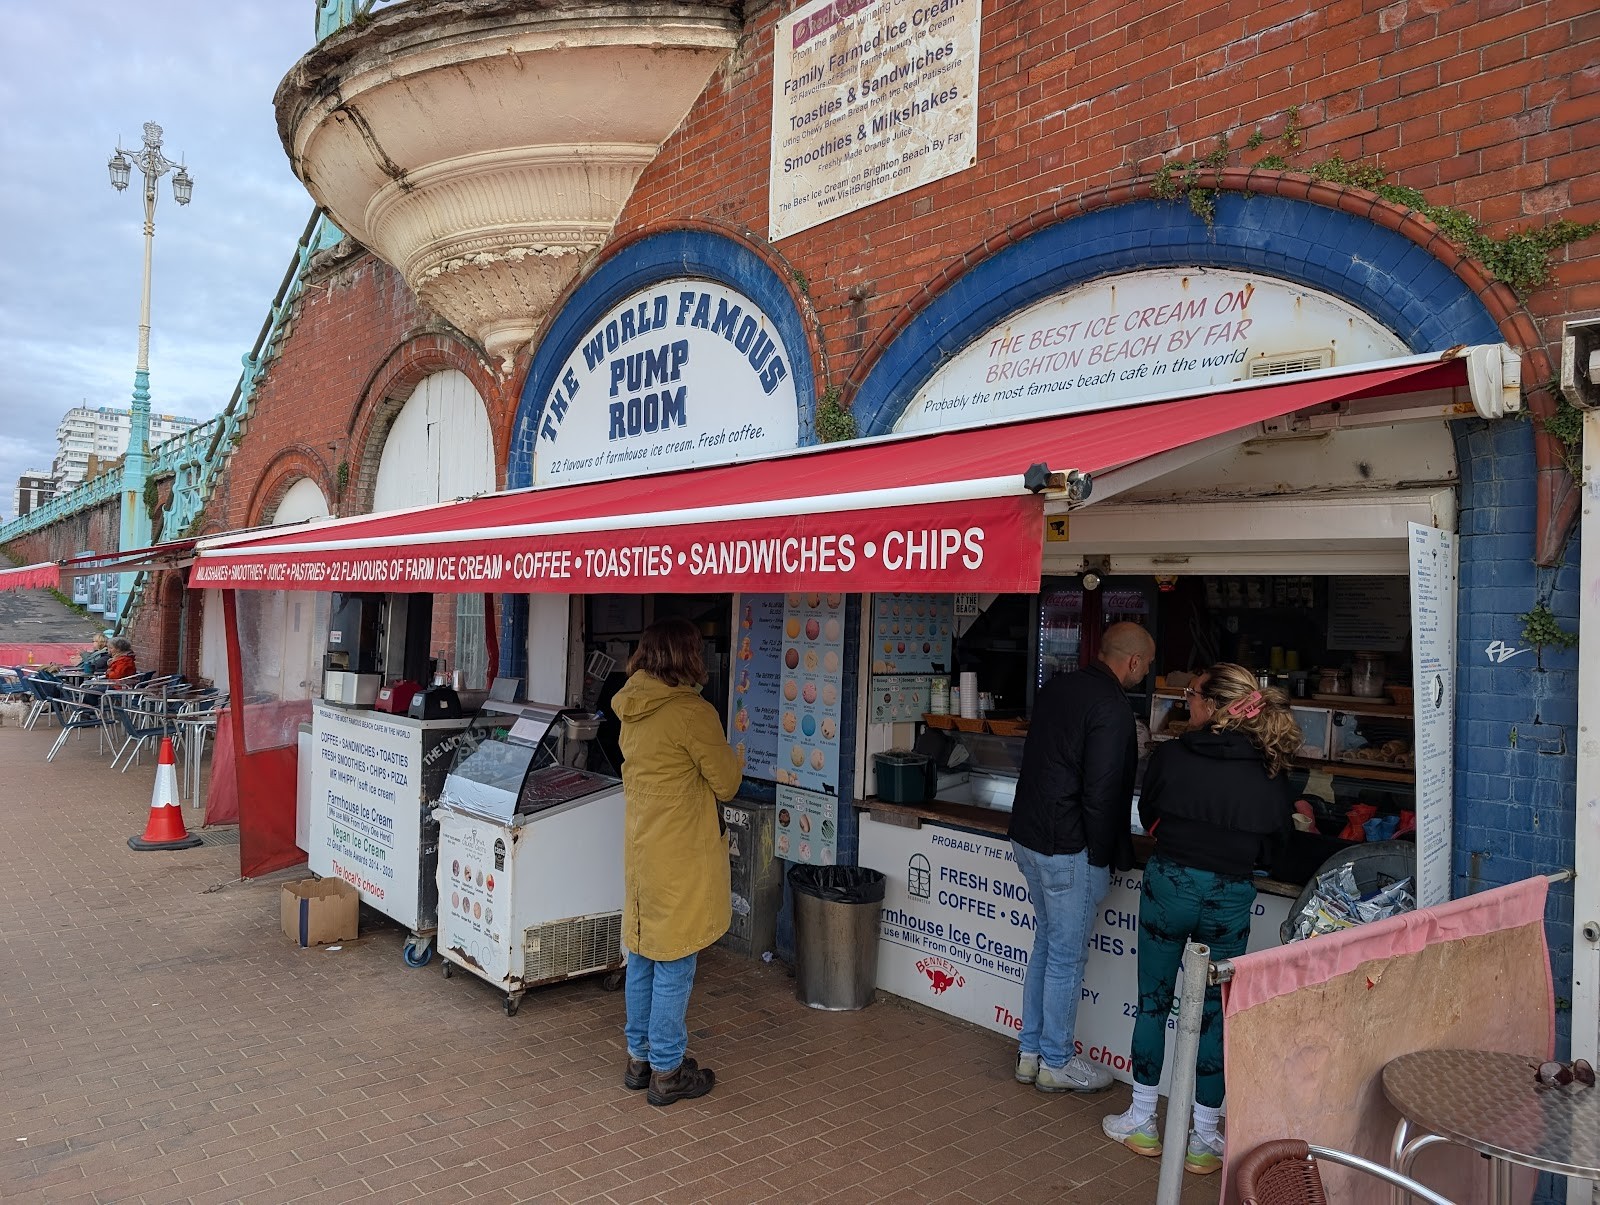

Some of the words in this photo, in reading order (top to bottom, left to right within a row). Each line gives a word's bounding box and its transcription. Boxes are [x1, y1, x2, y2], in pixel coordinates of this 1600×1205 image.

[784, 65, 824, 95] Family
[829, 30, 880, 71] Farmed
[886, 21, 907, 41] Ice
[790, 94, 798, 105] 22
[798, 81, 826, 101] Flavours
[836, 65, 858, 81] Family
[860, 47, 887, 68] Farmed
[915, 30, 927, 42] Ice
[928, 15, 955, 33] Cream
[814, 37, 827, 51] the
[783, 135, 800, 149] Using
[801, 125, 823, 139] Chewy
[824, 113, 846, 129] Brown
[847, 101, 868, 117] Bread
[870, 93, 887, 107] from
[889, 88, 901, 99] the
[903, 78, 920, 90] Real
[922, 58, 962, 80] Patisserie
[790, 97, 842, 131] Toasties
[847, 87, 857, 104] &
[861, 42, 954, 97] Sandwiches
[784, 133, 852, 173] Smoothies
[857, 124, 867, 141] &
[872, 86, 958, 135] Milkshakes
[817, 155, 842, 173] Freshly
[844, 148, 862, 160] Made
[864, 136, 891, 153] Orange
[893, 128, 913, 141] Juice
[779, 201, 792, 213] The
[793, 194, 810, 208] Best
[811, 189, 822, 200] Ice
[824, 178, 849, 194] Cream
[851, 173, 861, 183] on
[863, 157, 900, 178] Brighton
[902, 145, 930, 163] Beach
[932, 139, 945, 151] By
[947, 131, 964, 145] Far
[817, 164, 911, 208] www.VisitBrighton.com
[989, 333, 1026, 358] THE
[1028, 321, 1083, 350] BEST
[1083, 314, 1120, 340] ICE
[1124, 297, 1208, 332] CREAM
[1214, 287, 1256, 316] ON
[540, 366, 581, 444] THE
[582, 294, 669, 374] WORLD
[676, 291, 788, 396] FAMOUS
[609, 339, 690, 399] PUMP
[985, 348, 1084, 384] BRIGHTON
[1087, 334, 1162, 366] BEACH
[1166, 325, 1202, 353] BY
[1203, 318, 1253, 346] FAR
[923, 393, 970, 413] Probably
[971, 391, 991, 406] the
[993, 385, 1025, 403] most
[1026, 379, 1073, 397] famous
[1076, 369, 1116, 388] beach
[1119, 363, 1149, 382] cafe
[1152, 360, 1167, 376] in
[1171, 357, 1197, 374] the
[1201, 347, 1249, 370] world
[608, 385, 688, 442] ROOM
[551, 460, 561, 474] 22
[563, 458, 593, 472] flavours
[595, 452, 605, 467] of
[606, 446, 648, 465] farmhouse
[650, 444, 663, 457] ice
[665, 439, 695, 454] cream.
[698, 428, 726, 448] Fresh
[728, 423, 765, 443] coffee.
[195, 565, 229, 581] MILKSHAKES
[230, 563, 264, 581] SMOOTHIES
[266, 563, 288, 581] JUICE
[290, 562, 326, 581] PASTRIES
[330, 561, 341, 581] 22
[341, 559, 388, 581] FLAVOURS
[390, 558, 403, 581] OF
[405, 557, 434, 581] FARM
[436, 556, 455, 580] ICE
[458, 554, 503, 580] CREAM
[513, 551, 571, 579] COFFEE
[584, 544, 673, 578] TOASTIES
[688, 533, 856, 576] SANDWICHES
[882, 527, 985, 570] CHIPS
[966, 596, 977, 605] THE
[321, 731, 339, 747] COFFEE
[342, 738, 375, 758] SANDWICHES
[380, 749, 409, 768] TOASTIES
[322, 748, 336, 762] FRESH
[337, 753, 366, 773] SMOOTHIES
[370, 764, 387, 780] CHIPS
[391, 771, 408, 788] PIZZA
[423, 743, 443, 766] THE
[328, 789, 360, 815] Farmhouse
[361, 803, 370, 819] Ice
[371, 808, 393, 830] Cream
[378, 787, 396, 805] cream)
[332, 823, 351, 844] Vegan
[352, 832, 361, 848] Ice
[364, 838, 386, 861] Cream
[351, 816, 361, 828] From
[361, 821, 370, 835] Only
[371, 827, 379, 838] One
[931, 834, 981, 854] PROBABLY
[984, 846, 1002, 860] THE
[332, 859, 342, 875] The
[342, 866, 361, 888] local's
[362, 879, 385, 900] choice
[940, 866, 988, 892] FRESH
[938, 890, 996, 920] COFFEE
[884, 927, 900, 938] use
[902, 930, 920, 945] Milk
[922, 937, 947, 954] From
[949, 945, 972, 963] Only
[974, 953, 994, 969] One
[997, 960, 1025, 981] Herd)
[949, 923, 971, 946] Ice
[975, 932, 1028, 964] Cream
[915, 956, 966, 988] BENNETTS
[994, 1005, 1023, 1031] The
